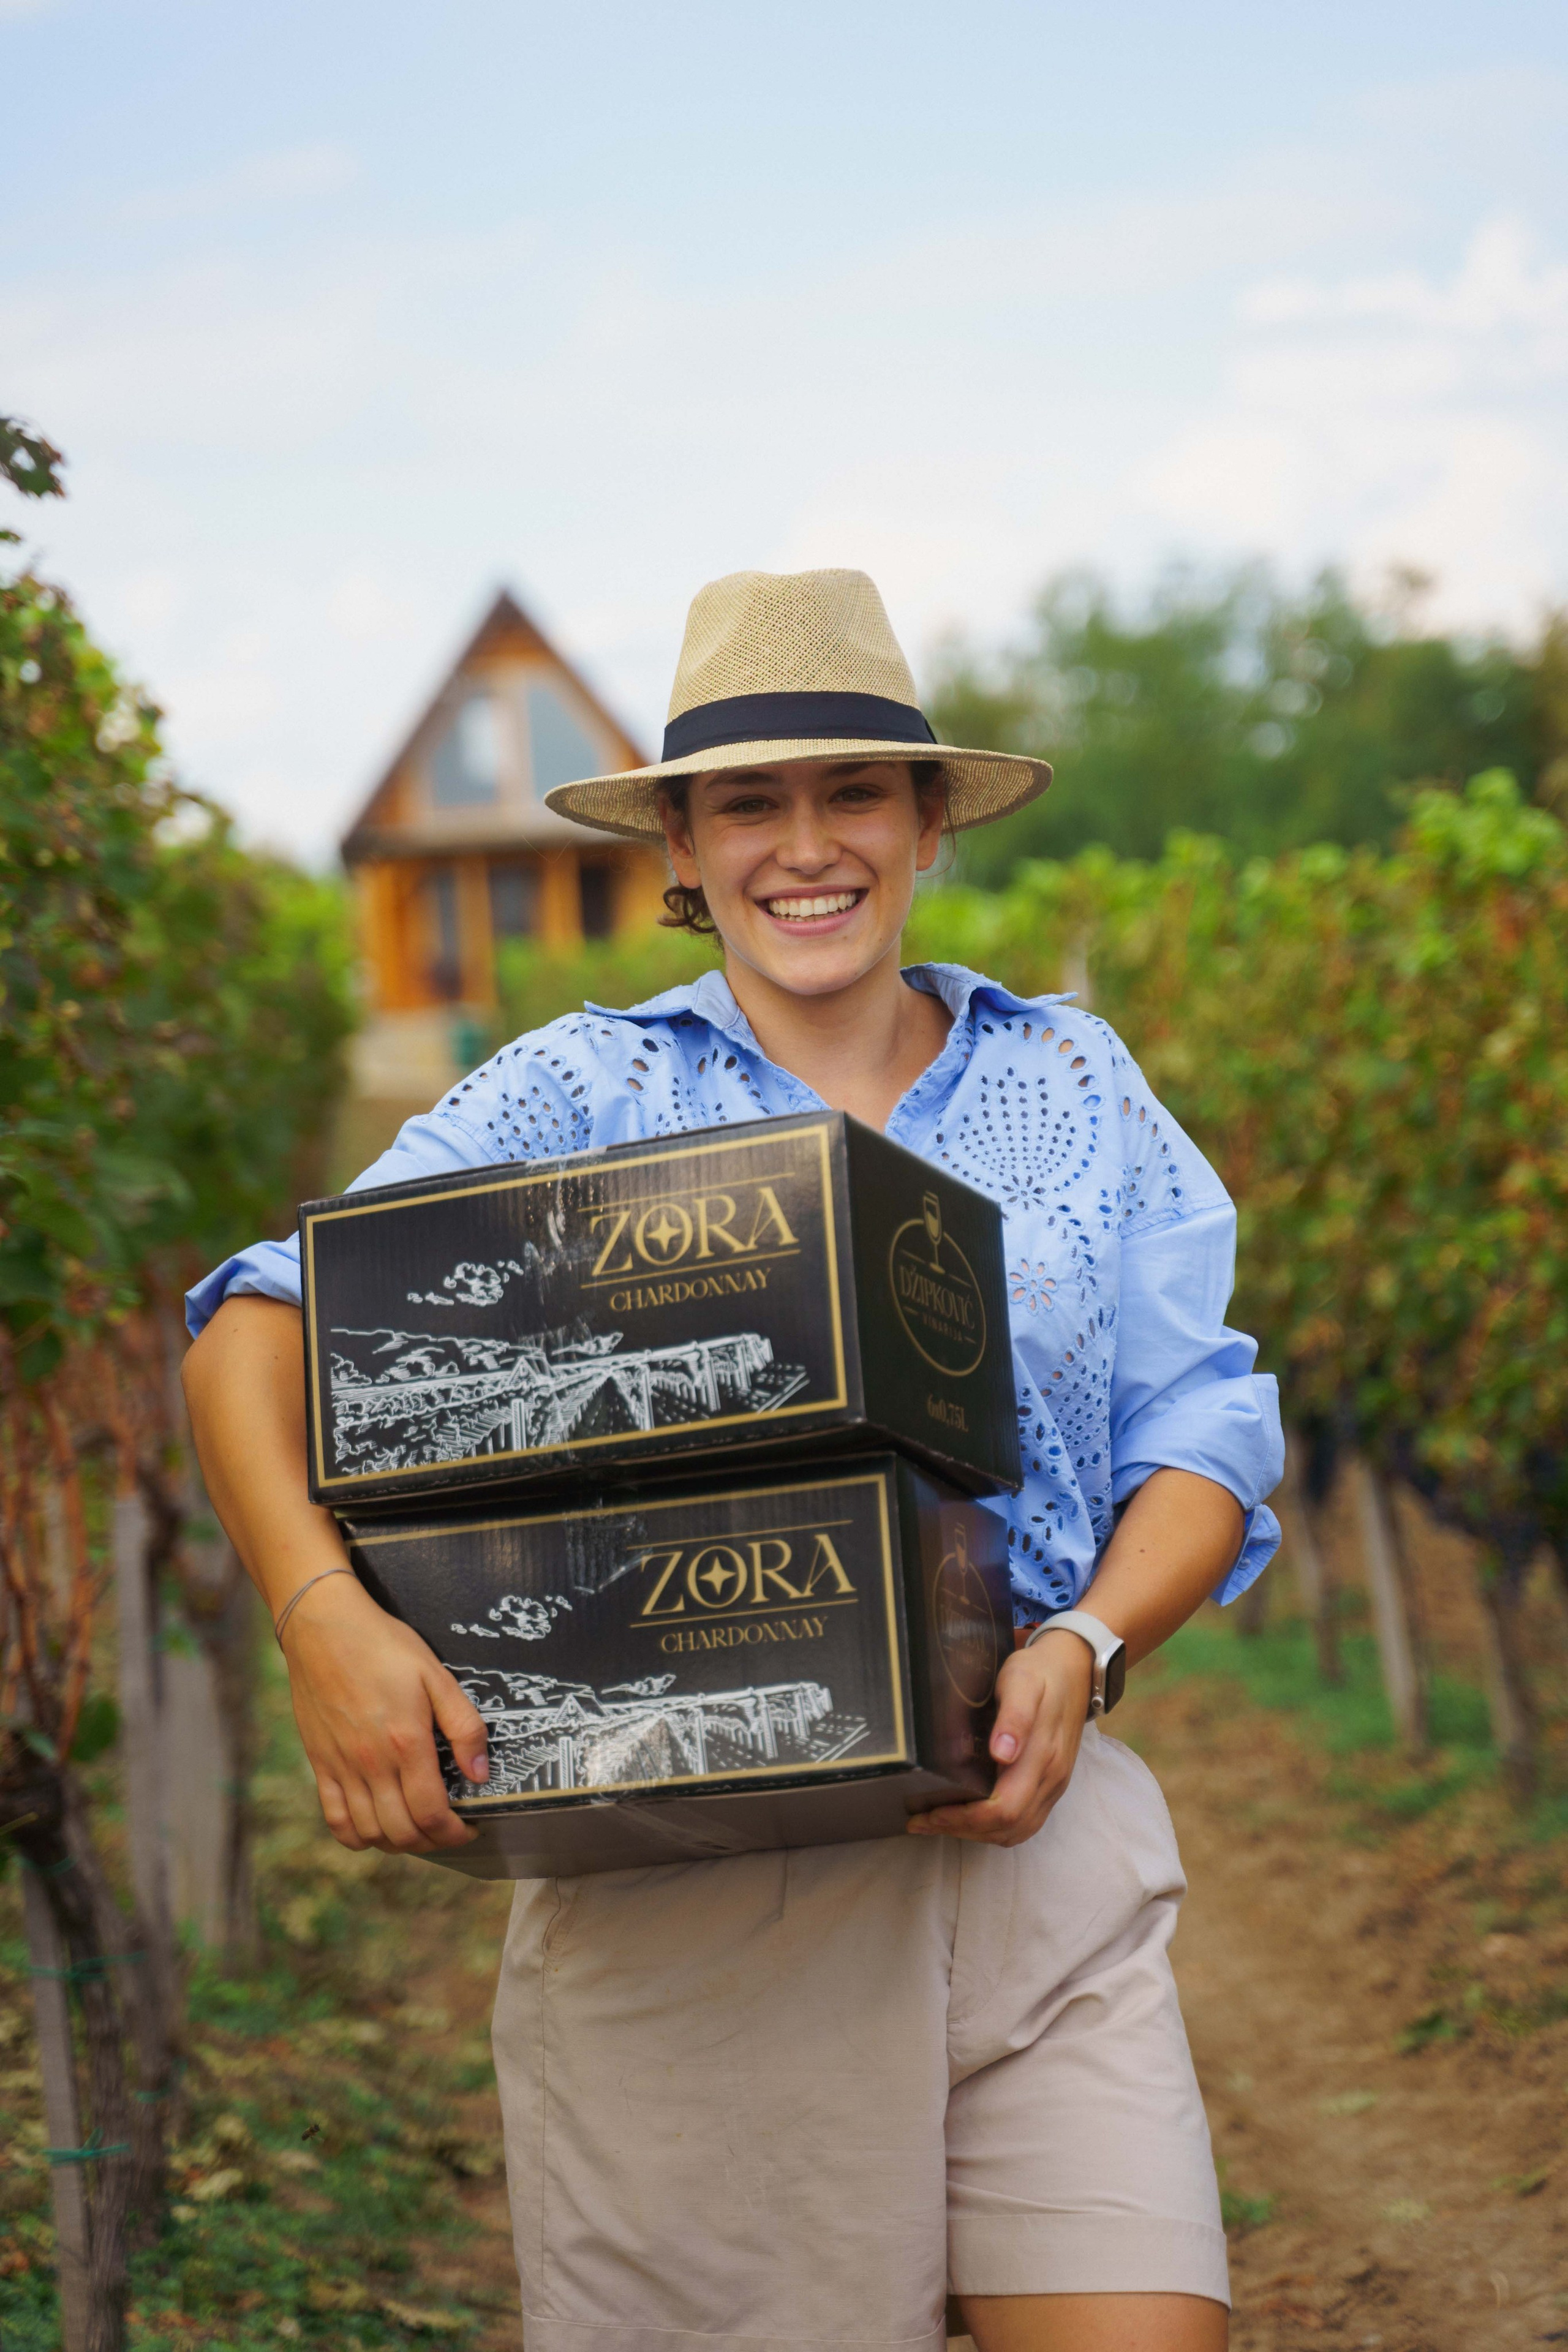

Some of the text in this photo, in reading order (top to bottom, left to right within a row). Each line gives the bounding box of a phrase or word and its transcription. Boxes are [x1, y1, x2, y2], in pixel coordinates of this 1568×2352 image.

[589, 1186, 799, 1276] ZORA
[609, 1267, 772, 1313] CHARDONNAY
[641, 1534, 857, 1616] ZORA
[660, 1616, 828, 1653] CHARDONNAY
